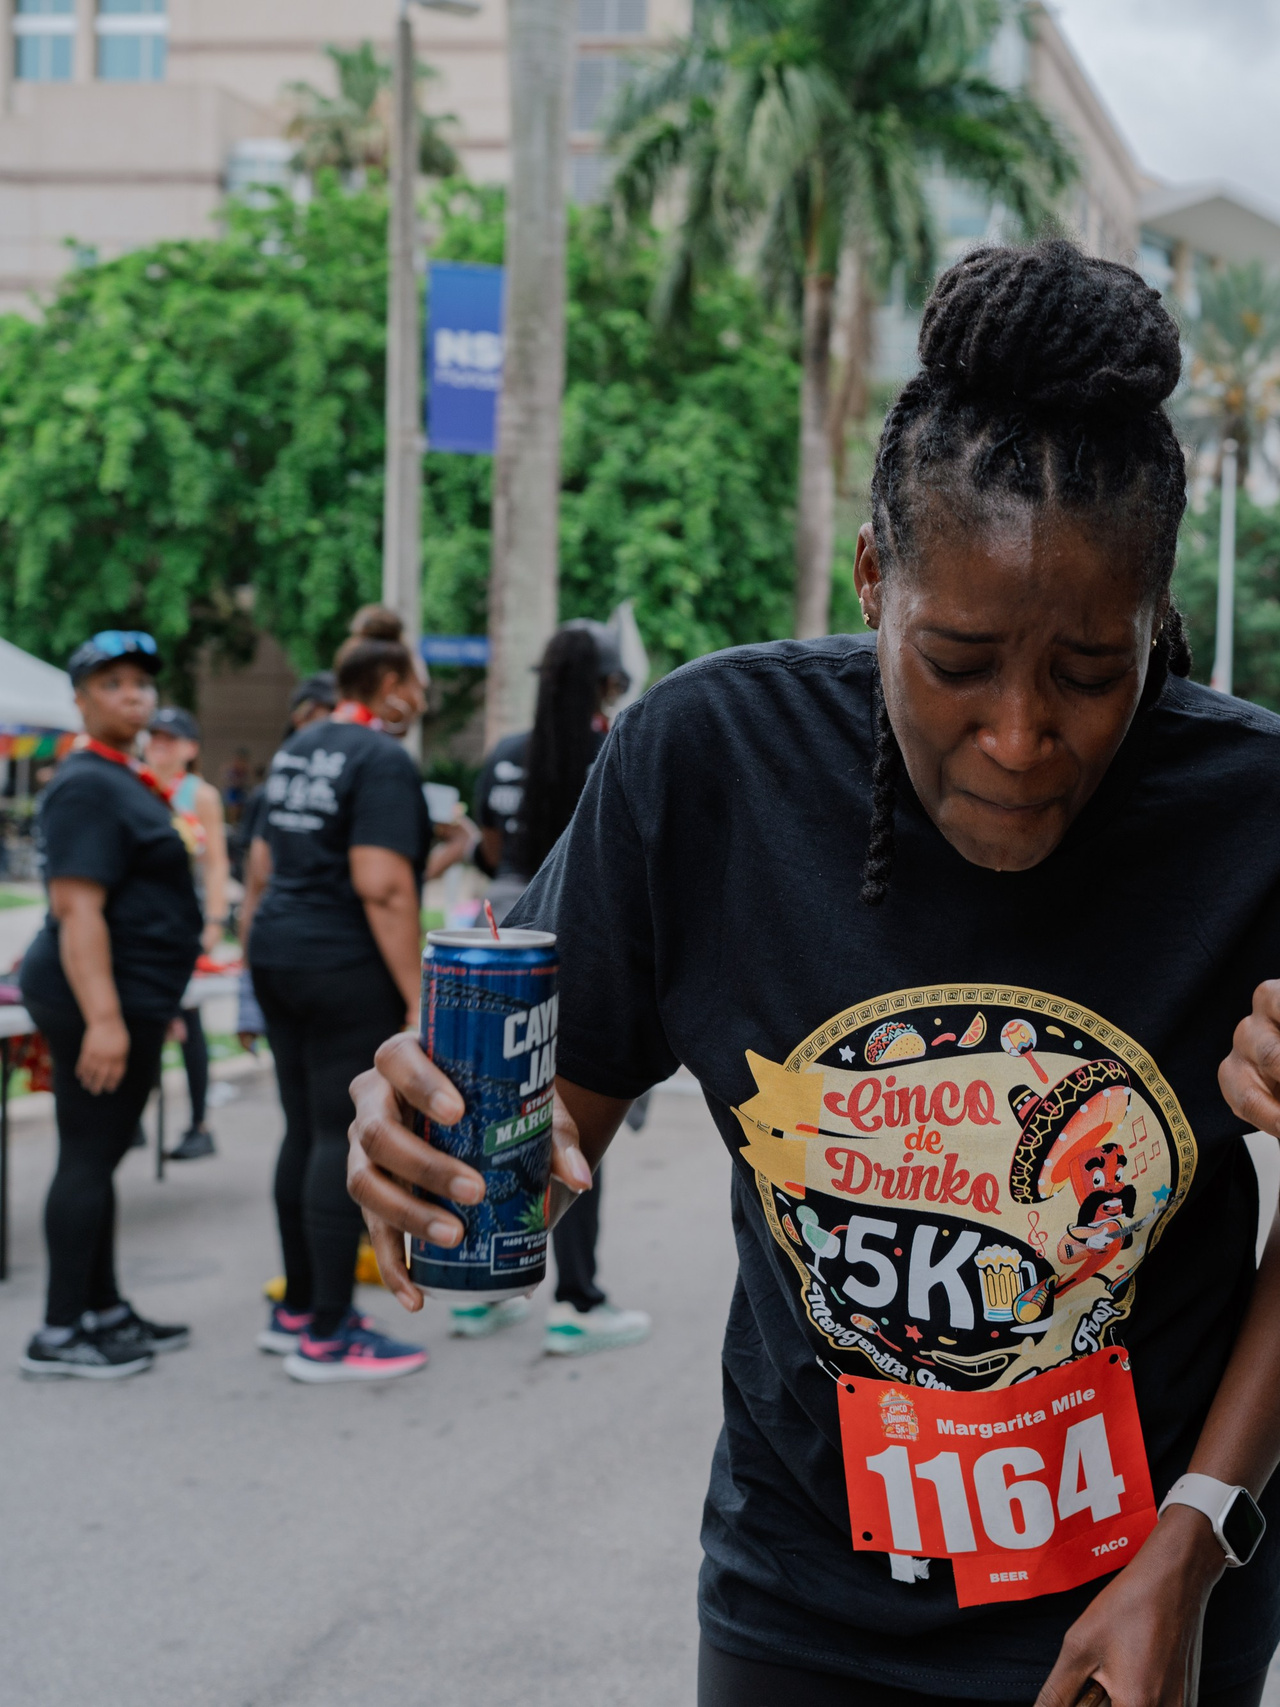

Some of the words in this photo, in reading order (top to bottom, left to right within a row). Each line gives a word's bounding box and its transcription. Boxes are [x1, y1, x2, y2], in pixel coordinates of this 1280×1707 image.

[823, 1075, 1002, 1132] Cinco
[904, 1124, 944, 1154] de
[825, 1147, 1003, 1215] Drinko
[842, 1215, 981, 1330] 5K
[808, 1281, 908, 1381] Margarita
[1074, 1300, 1121, 1352] Trot
[889, 1404, 908, 1414] CINCO
[936, 1410, 1047, 1439] Margarita
[1051, 1387, 1096, 1416] Mile
[865, 1412, 1126, 1554] 1164
[989, 1571, 1029, 1583] BEER
[1091, 1536, 1129, 1557] TACO
